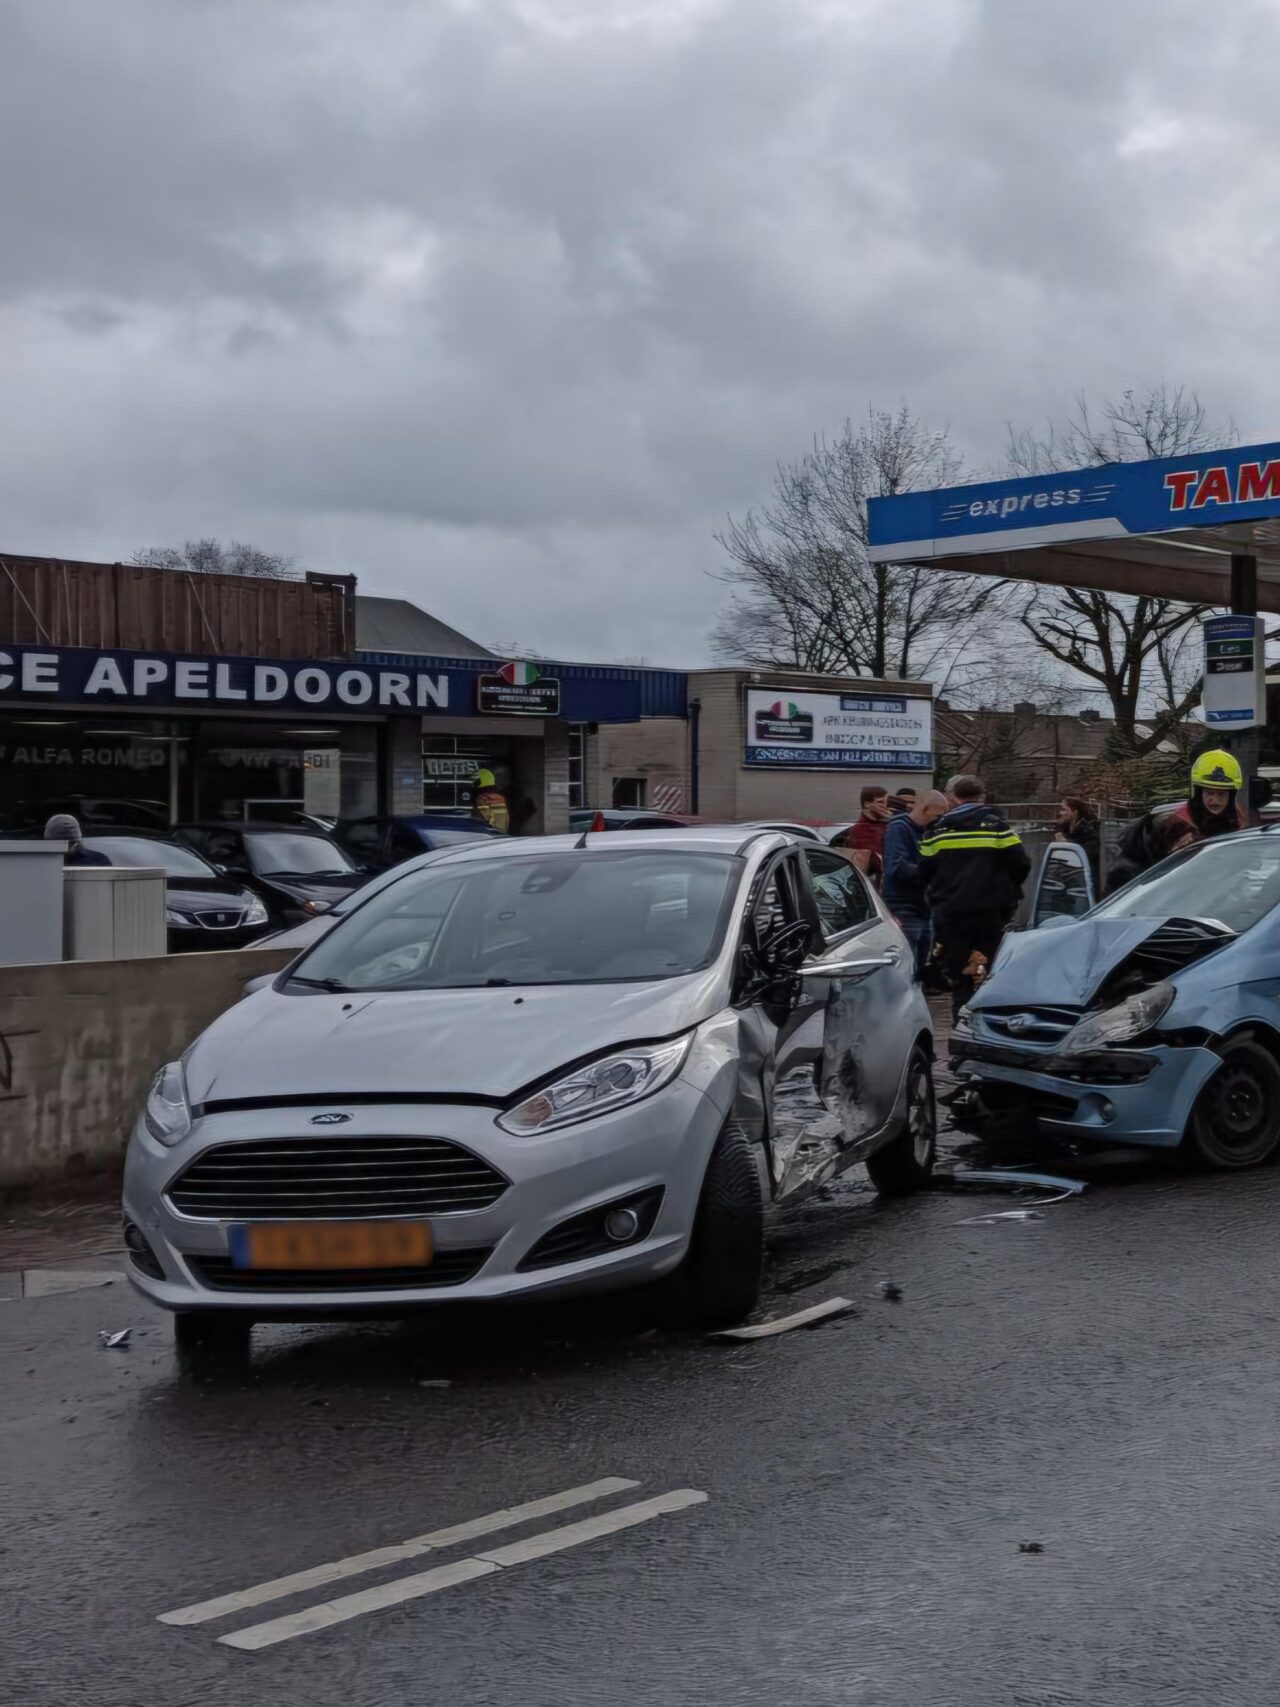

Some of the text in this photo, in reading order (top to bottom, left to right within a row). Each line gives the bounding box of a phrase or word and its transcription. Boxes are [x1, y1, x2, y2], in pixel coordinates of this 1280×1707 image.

[969, 487, 1081, 517] express
[83, 657, 449, 708] APELDOORN
[12, 747, 74, 765] ALFA
